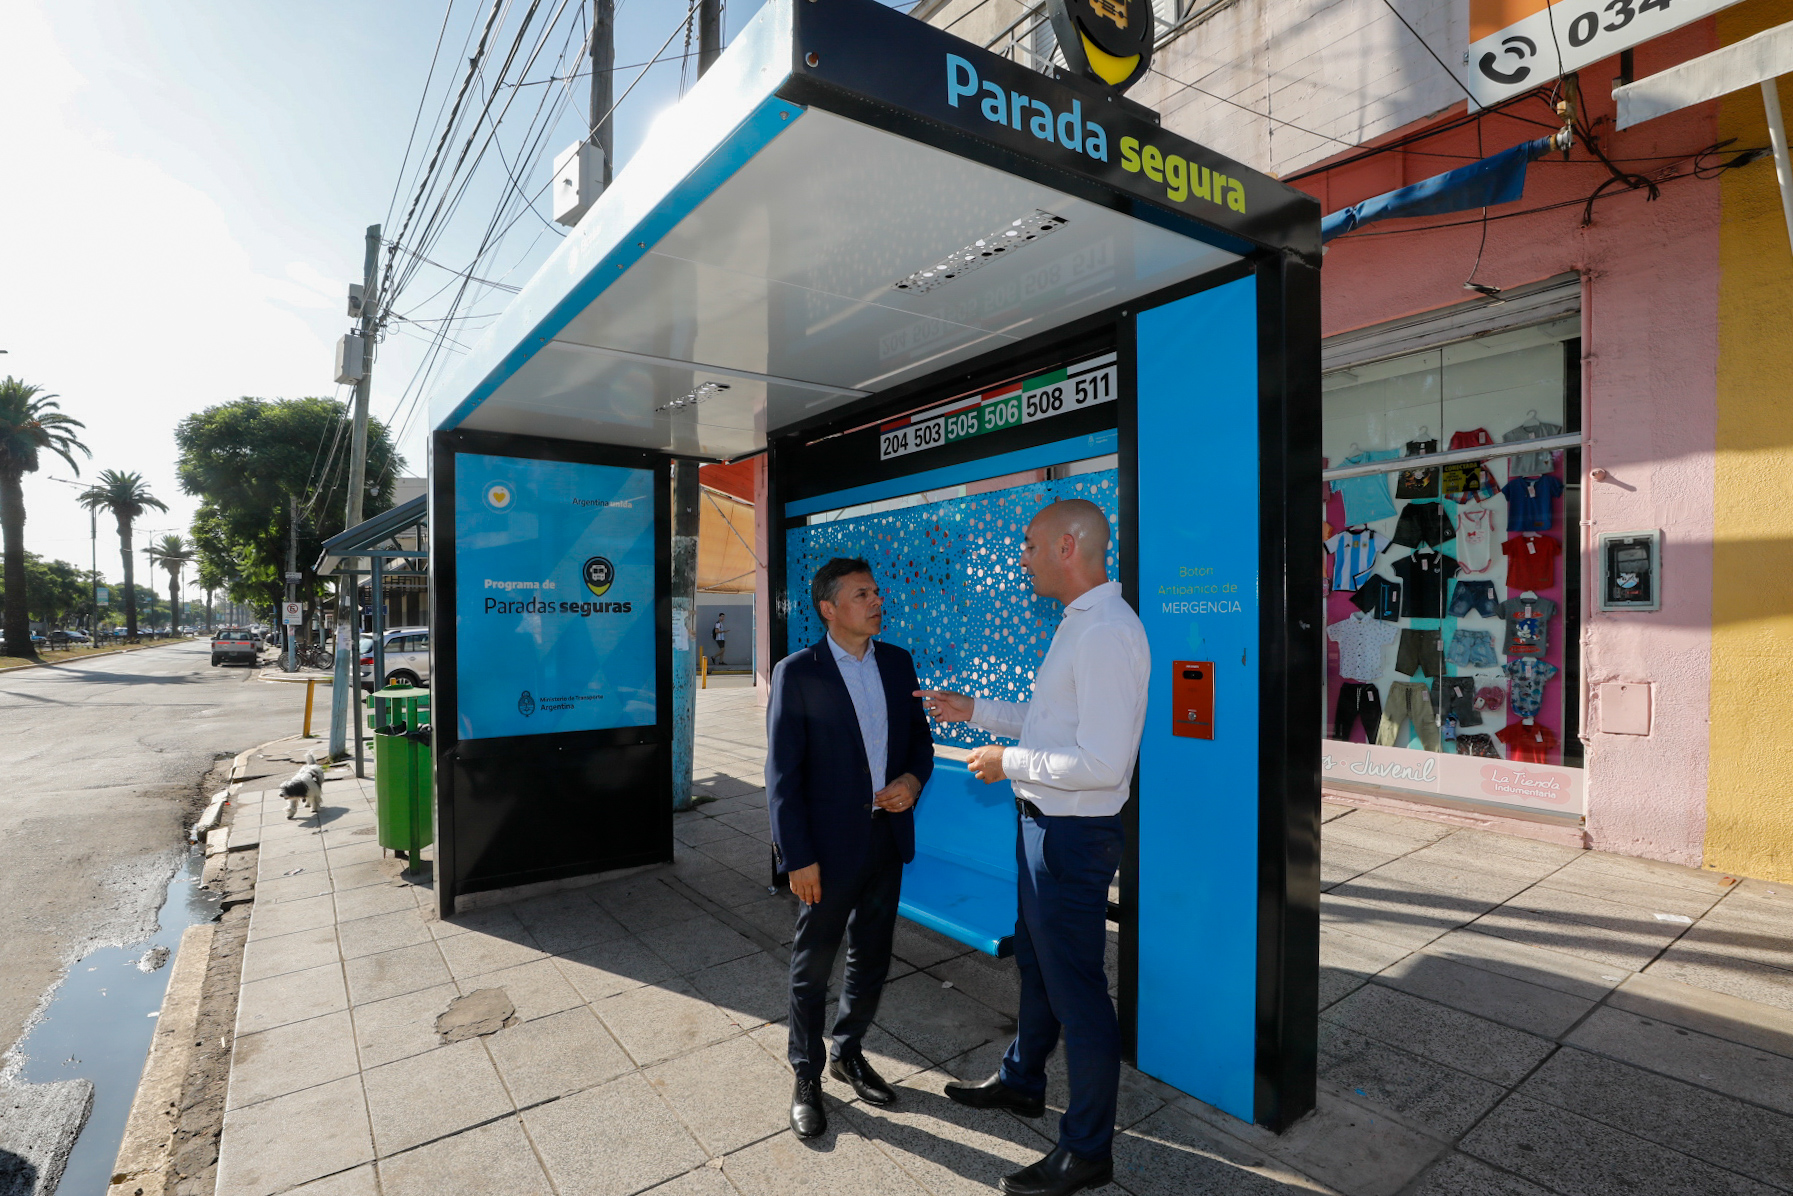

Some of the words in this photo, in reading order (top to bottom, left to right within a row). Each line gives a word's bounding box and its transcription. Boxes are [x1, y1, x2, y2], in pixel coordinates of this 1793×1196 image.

[946, 52, 1108, 163] Parada
[1119, 135, 1247, 215] segura
[883, 432, 909, 457] 204
[914, 422, 942, 448] 503
[947, 411, 979, 440] 505
[984, 400, 1019, 430] 506
[1026, 387, 1064, 418] 508
[1075, 372, 1110, 404] 511
[572, 497, 609, 507] Argentina
[610, 499, 633, 509] unida
[484, 579, 540, 592] Programa
[542, 579, 556, 590] de
[1222, 582, 1238, 594] de
[484, 597, 556, 615] Paradas
[559, 600, 632, 617] seguras
[1162, 600, 1242, 614] MERGENCIA
[540, 695, 567, 703] Ministerio
[540, 702, 575, 713] Argentina
[1350, 750, 1437, 784] Juvenil
[1490, 768, 1510, 785] La
[1511, 771, 1561, 791] Tienda
[1494, 783, 1558, 800] Indumentaria
